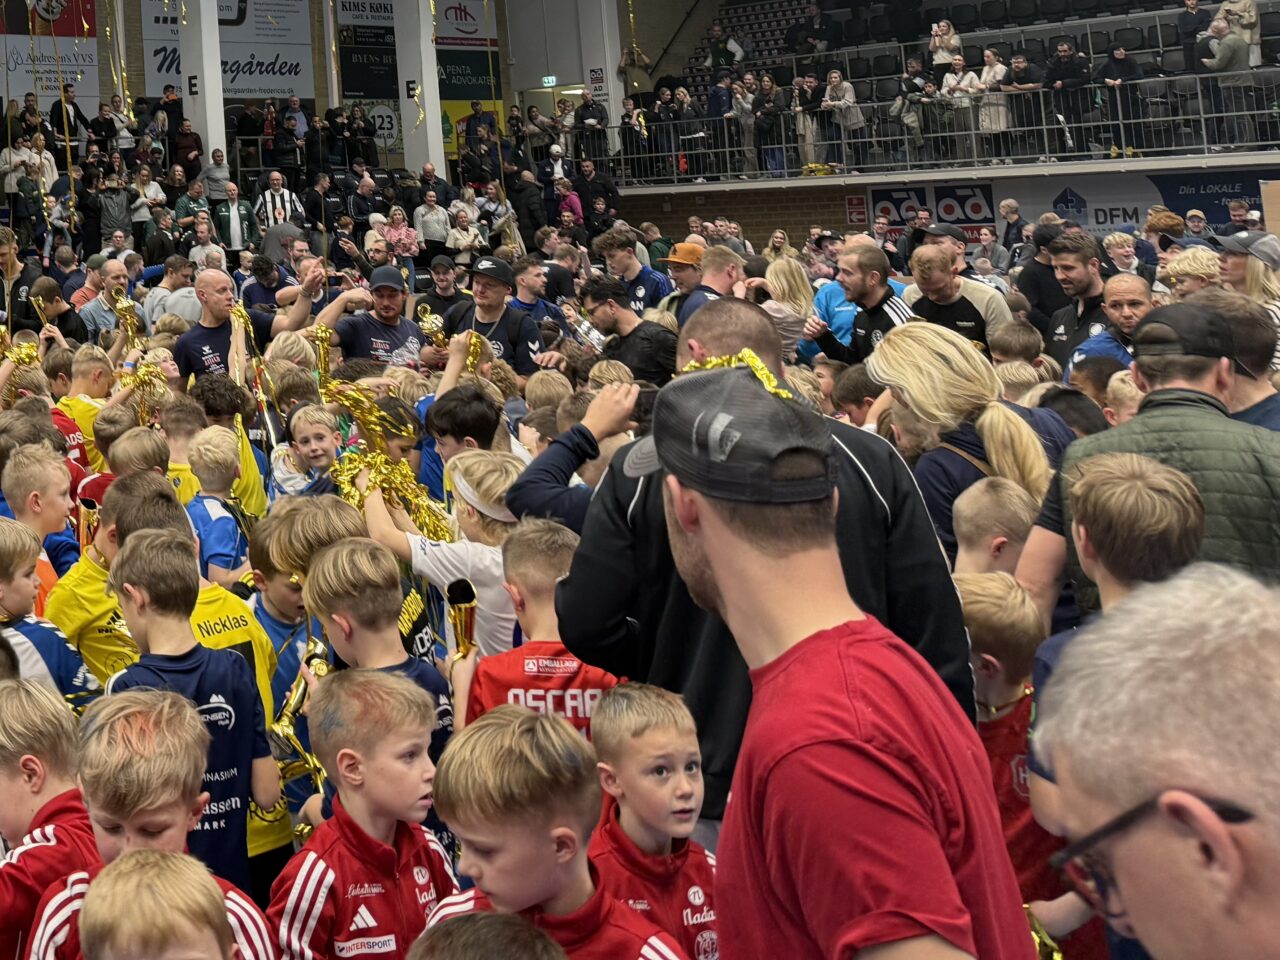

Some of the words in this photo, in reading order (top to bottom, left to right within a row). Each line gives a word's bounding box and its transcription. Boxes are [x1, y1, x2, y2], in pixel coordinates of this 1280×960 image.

[341, 0, 367, 12] KIMS
[25, 52, 72, 64] Andresn's
[73, 52, 94, 64] VVS
[446, 64, 471, 74] PENTA
[188, 75, 199, 95] E
[406, 80, 417, 98] E
[371, 114, 394, 130] 123
[1179, 185, 1196, 194] Din
[1200, 183, 1243, 194] LOKALE
[1094, 206, 1140, 225] DFM
[197, 612, 249, 639] Nicklas
[344, 938, 393, 953] INTERSPORT
